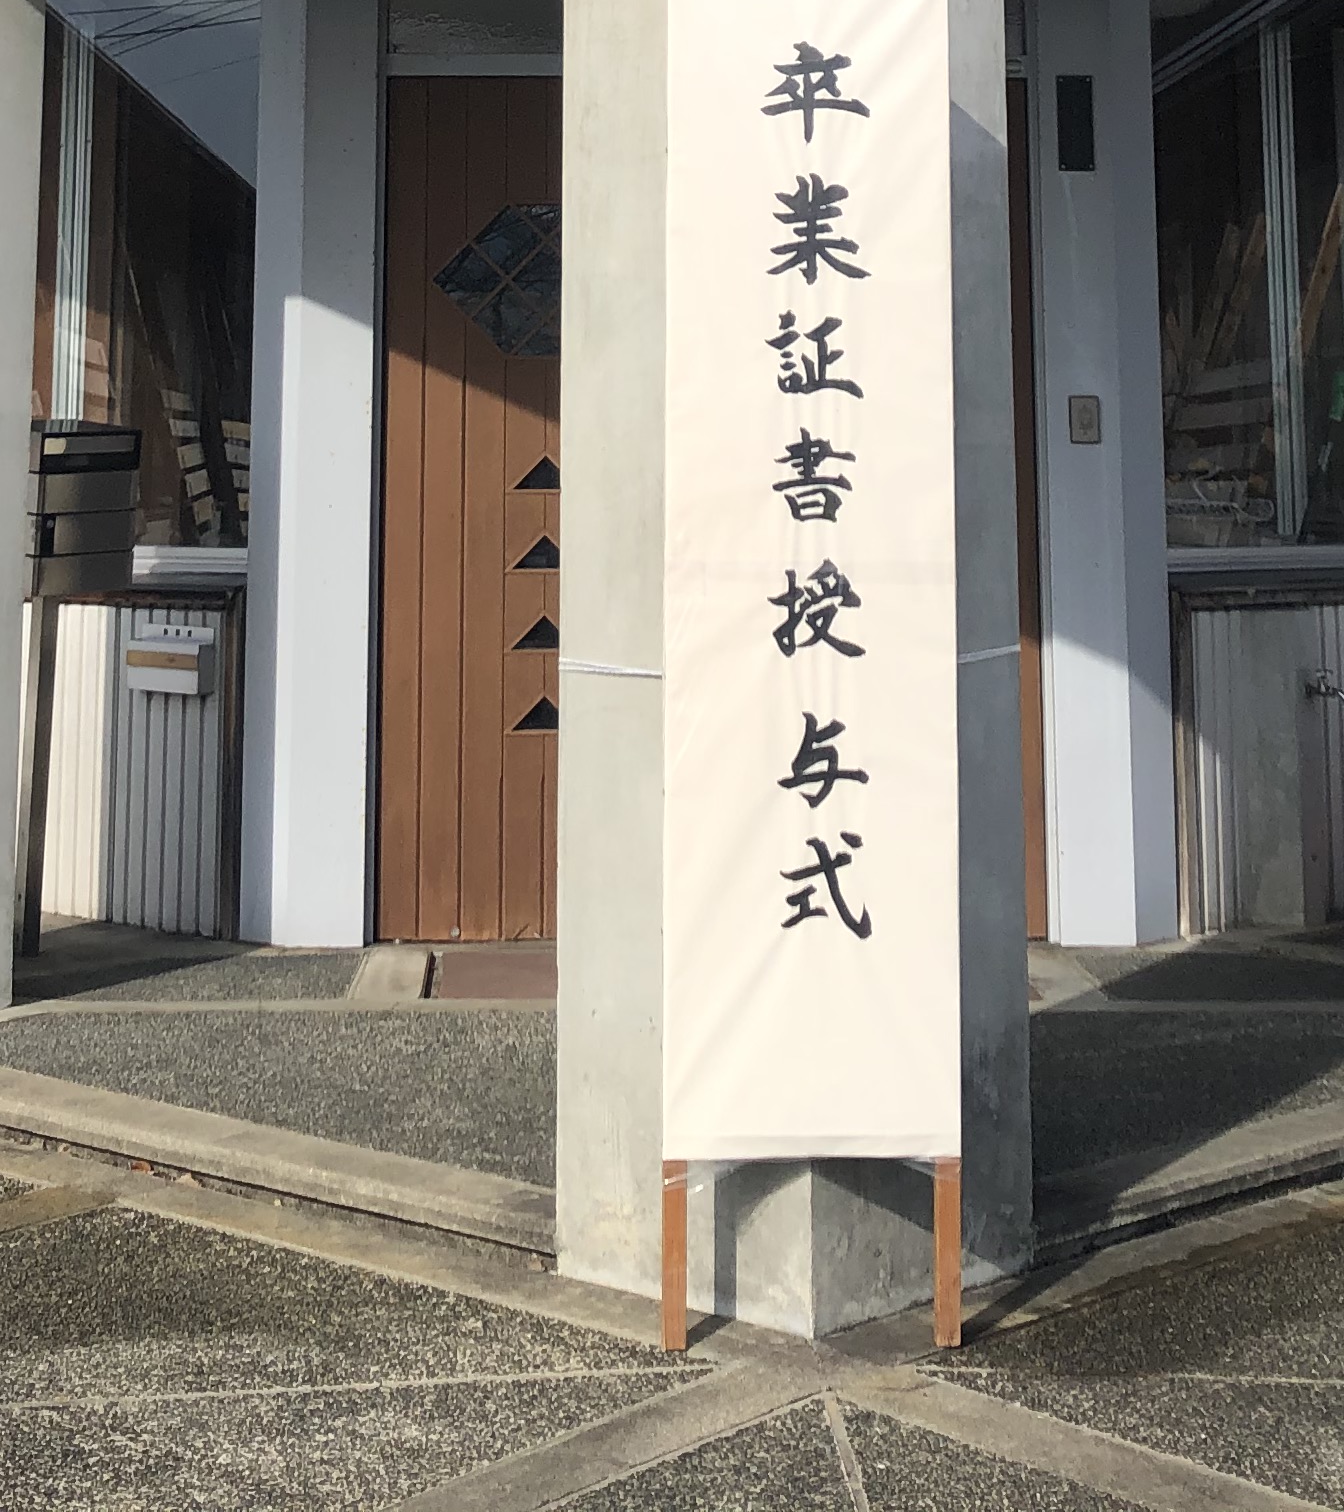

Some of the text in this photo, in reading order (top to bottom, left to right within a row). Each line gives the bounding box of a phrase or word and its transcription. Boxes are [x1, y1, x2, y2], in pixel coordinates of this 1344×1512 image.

[760, 41, 872, 939] 卒業証書授与式
